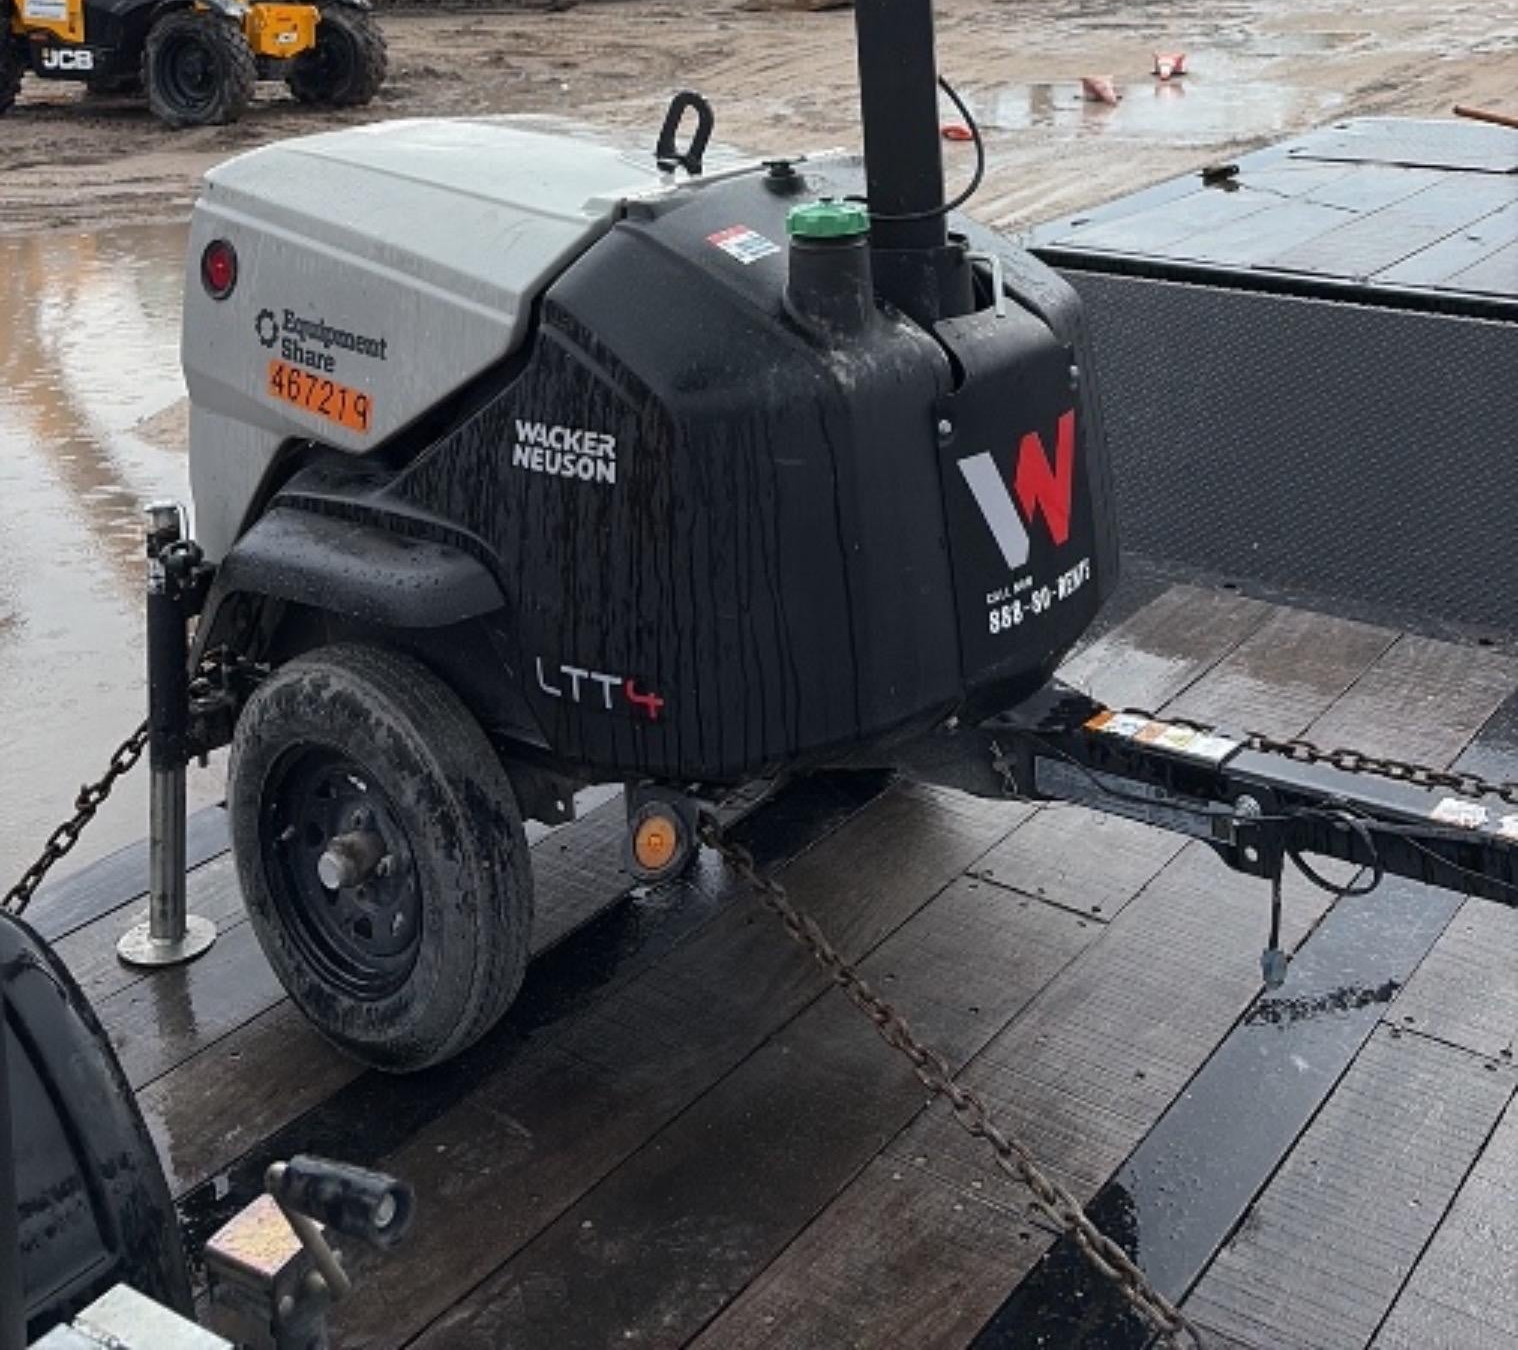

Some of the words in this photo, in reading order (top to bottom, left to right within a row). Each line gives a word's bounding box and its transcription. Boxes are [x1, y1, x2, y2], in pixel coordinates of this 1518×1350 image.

[41, 48, 95, 71] JCB
[281, 308, 388, 361] Equipment
[281, 336, 336, 373] Share
[270, 364, 368, 430] 467219
[515, 419, 617, 461] WACKER
[512, 443, 617, 484] NEUSON
